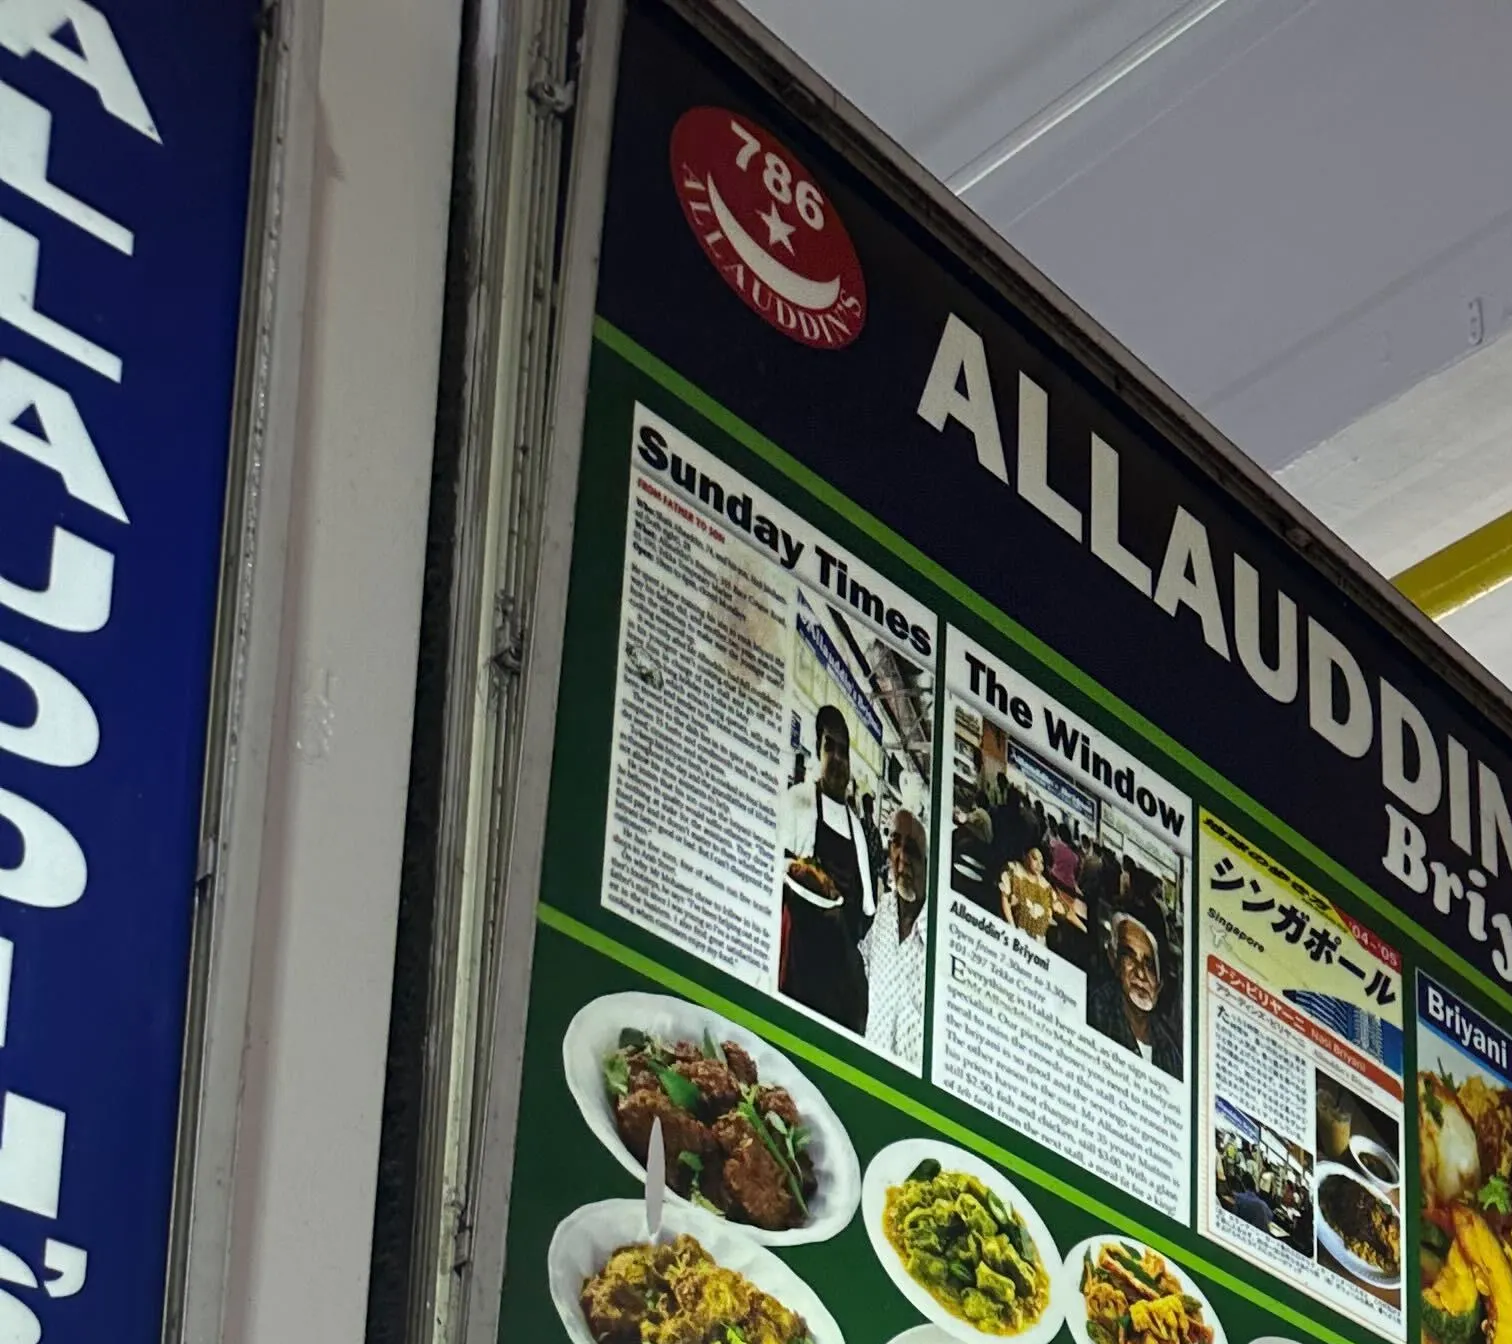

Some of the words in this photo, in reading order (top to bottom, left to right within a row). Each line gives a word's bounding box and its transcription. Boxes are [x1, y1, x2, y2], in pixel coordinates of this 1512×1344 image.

[731, 119, 825, 231] 786
[681, 161, 863, 344] ALLAUDDIN'S
[637, 425, 804, 570] Sunday
[814, 545, 932, 657] Times
[964, 651, 1033, 729] The
[1043, 706, 1185, 837] Window
[949, 900, 1008, 946] Allauddin's
[1012, 937, 1050, 971] Briyani
[1207, 906, 1265, 953] Singapore
[1210, 857, 1396, 1006] シンガポール
[1428, 988, 1508, 1071] Briyani
